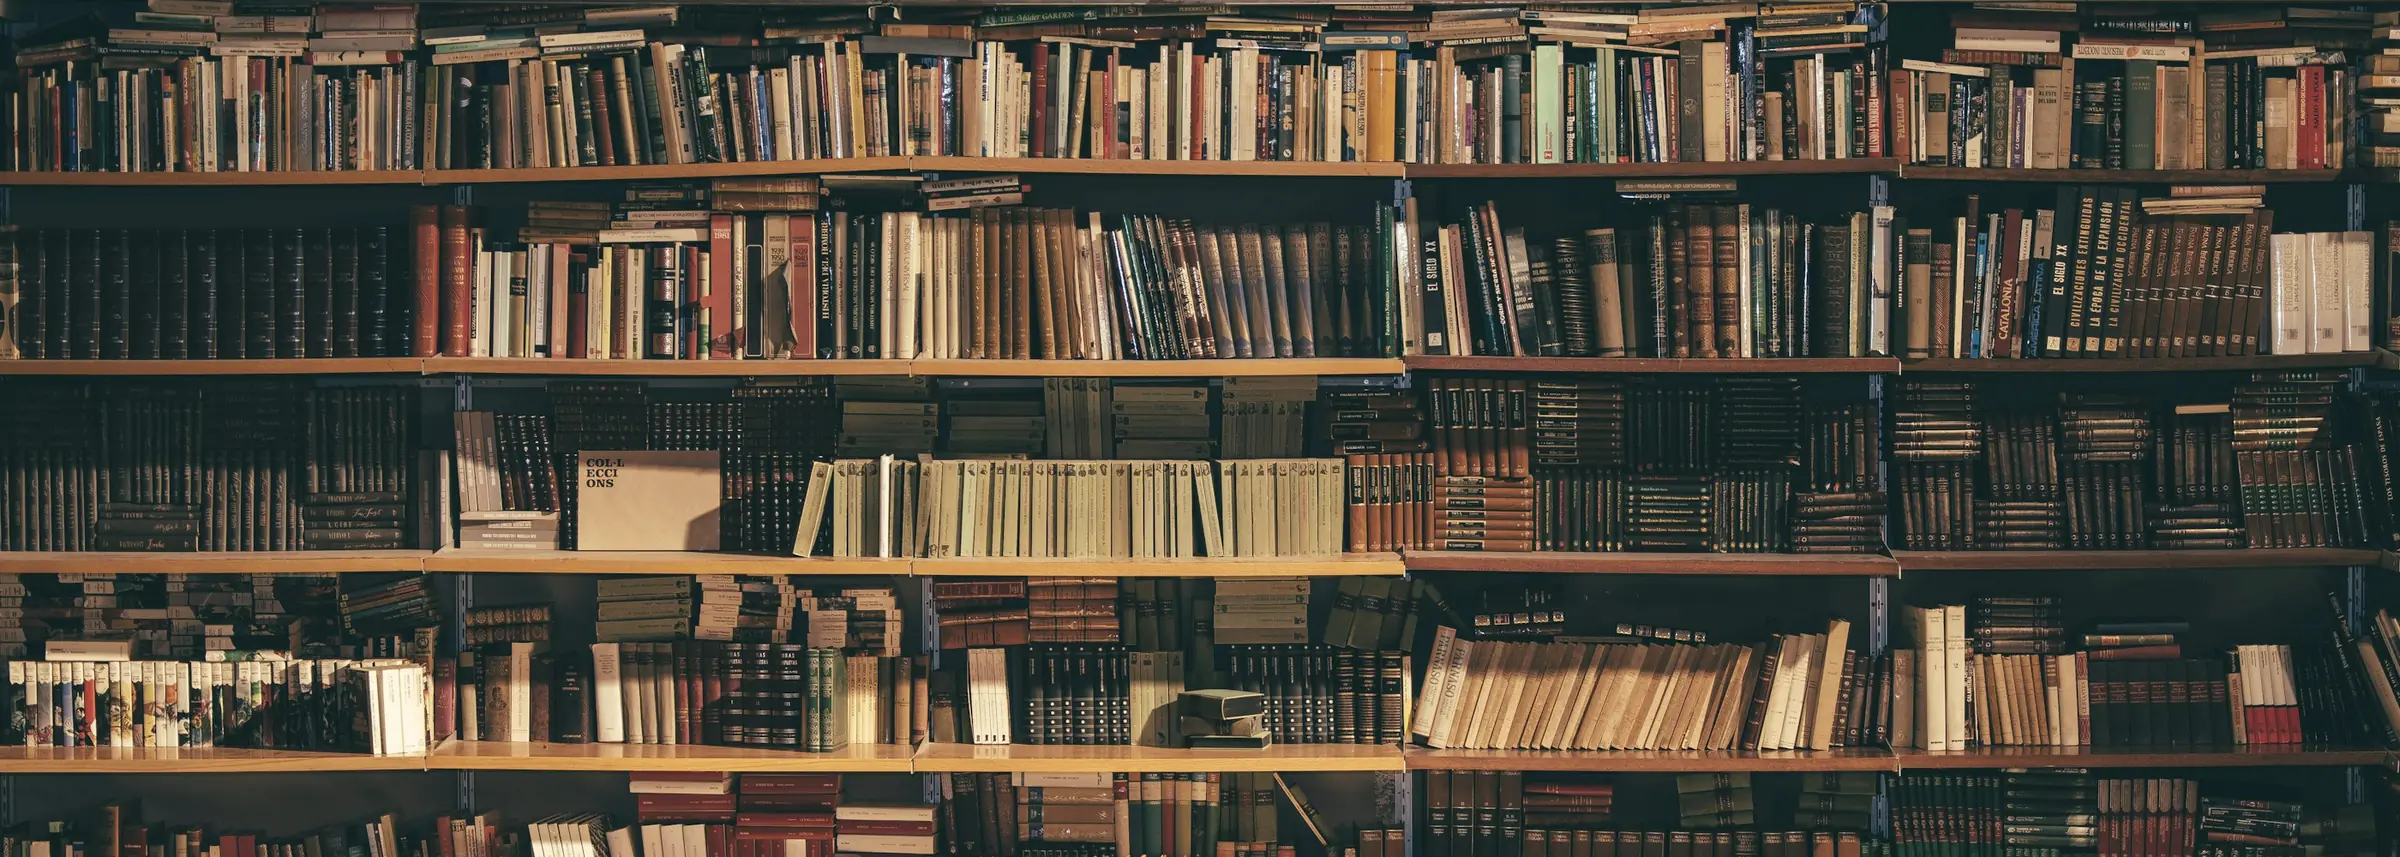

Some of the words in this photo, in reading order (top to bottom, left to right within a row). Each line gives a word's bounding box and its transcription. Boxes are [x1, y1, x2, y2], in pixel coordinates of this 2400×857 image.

[1042, 12, 1074, 20] GARDEN
[2077, 46, 2101, 56] INOCENTE
[2101, 46, 2125, 57] PRESUNTO
[1283, 115, 1293, 131] 45
[1566, 115, 1576, 132] Dan
[1869, 98, 1880, 129] FREDERICK
[1566, 132, 1576, 161] Benson
[1869, 128, 1880, 153] FORSYTH
[1634, 193, 1663, 201] dorado
[1664, 193, 1671, 201] el
[820, 219, 829, 255] HOMBRE
[2077, 197, 2094, 257] EXTINGUIDAS
[2097, 201, 2113, 251] EXPANSIÓN
[2117, 200, 2132, 253] OCCIDENTAL
[2244, 223, 2255, 248] FAUNA
[1425, 240, 1437, 252] XX
[1486, 236, 1494, 256] GATA
[1752, 236, 1764, 247] 10
[2130, 227, 2139, 250] FAUNA
[2144, 229, 2154, 251] FAUNA
[2188, 227, 2198, 249] FAUNA
[2201, 226, 2211, 249] FAUNA
[2215, 227, 2225, 249] FAUNA
[2230, 225, 2240, 250] FAUNA
[2258, 225, 2268, 250] FAUNA
[2040, 246, 2045, 256] 1
[2056, 244, 2068, 257] XX
[2096, 255, 2107, 265] LA
[820, 258, 829, 280] DEL
[1426, 257, 1438, 279] SIGLO
[1490, 258, 1496, 267] DE
[2054, 261, 2066, 281] SIGLO
[1427, 282, 1438, 291] EL
[1492, 268, 1501, 294] SIERRA
[2033, 262, 2045, 303] LATINA
[2093, 269, 2105, 283] DE
[2109, 256, 2126, 312] CIVILIZACIÓN
[820, 281, 829, 319] HISTORIA
[2053, 283, 2064, 296] EL
[2070, 258, 2087, 327] CIVILIZACIONES
[2090, 285, 2103, 312] ÉPOCA
[1998, 277, 2013, 340] CATALONIA
[2089, 312, 2100, 327] LA
[2108, 313, 2119, 327] LA
[2375, 416, 2384, 442] ESPAÑA
[2379, 444, 2386, 453] DE
[586, 469, 618, 478] ECCI
[2382, 454, 2391, 484] TESOROS
[586, 479, 614, 488] ONS
[2386, 487, 2394, 501] LOS
[1429, 633, 1450, 685] PARNASO
[1445, 647, 1466, 699] PARNASO
